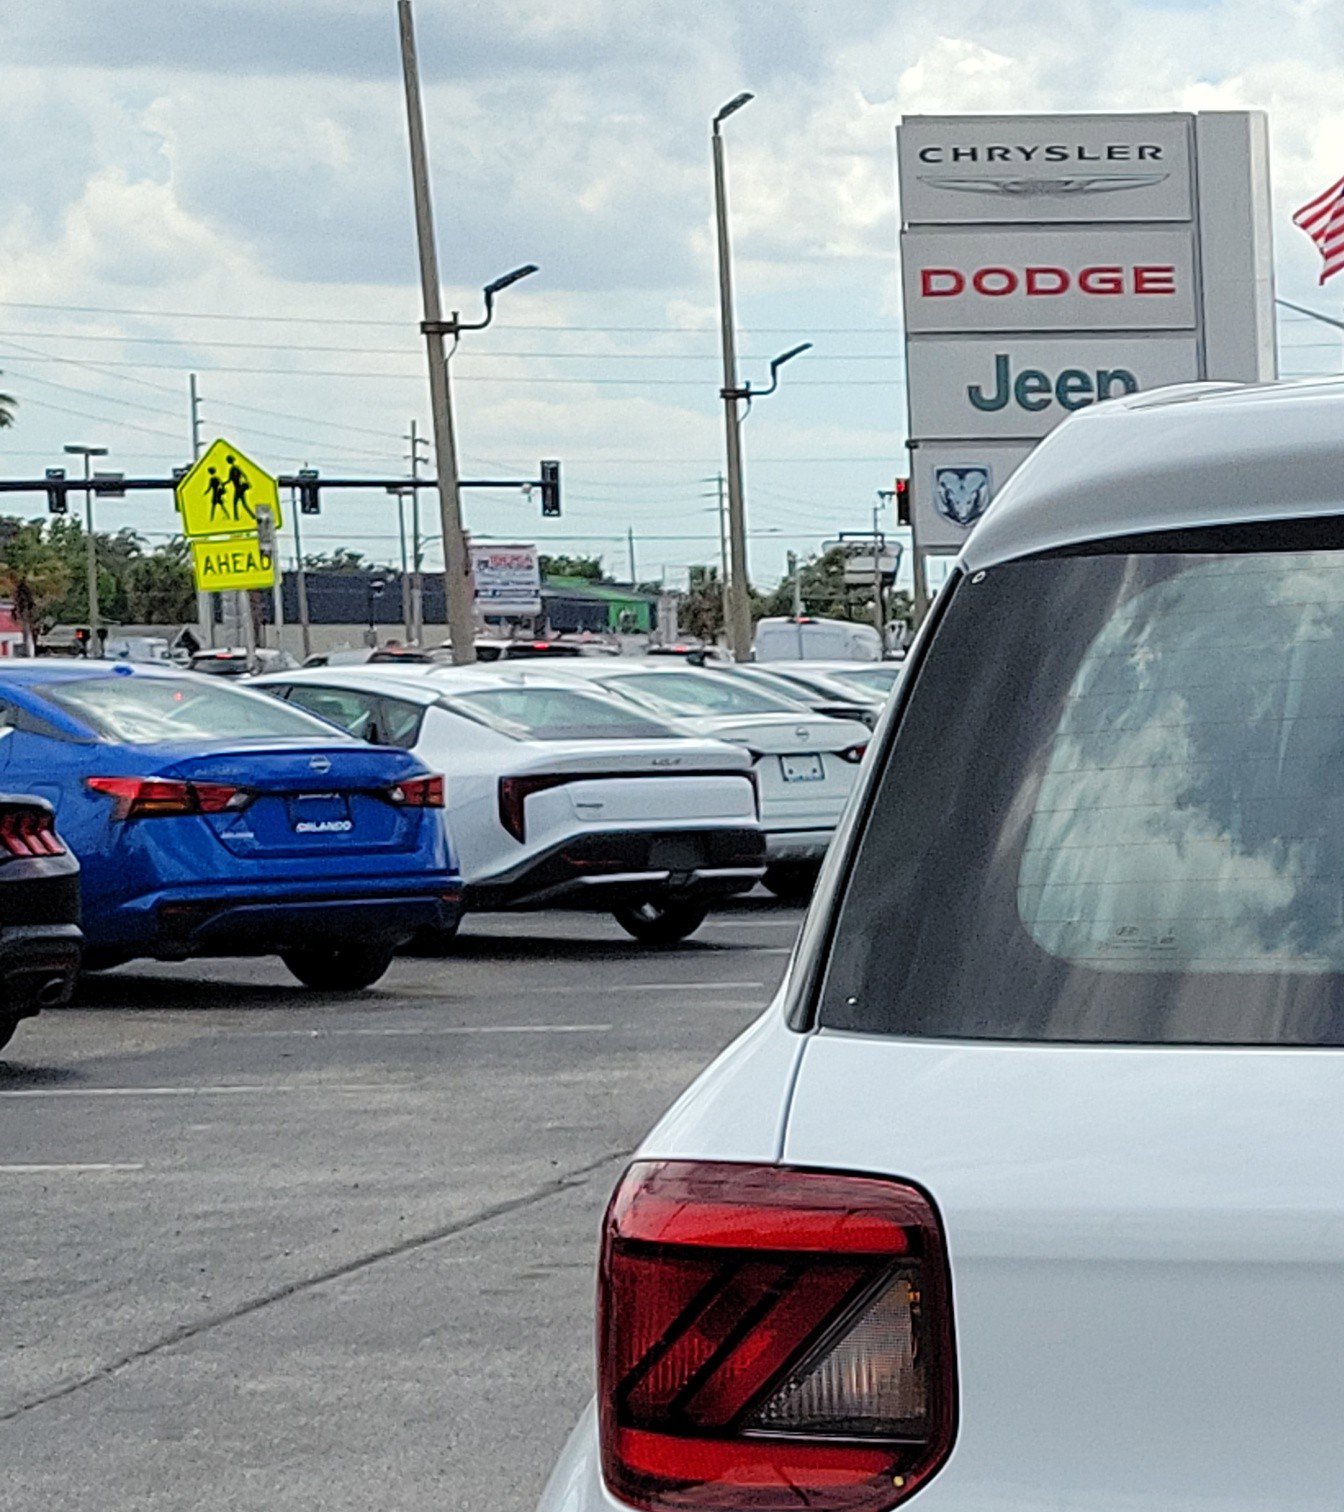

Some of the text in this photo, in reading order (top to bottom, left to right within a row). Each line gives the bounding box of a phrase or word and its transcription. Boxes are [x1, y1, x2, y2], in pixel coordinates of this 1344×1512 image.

[918, 145, 1164, 163] CHRYSLER
[920, 266, 1177, 297] DODGE
[203, 551, 272, 575] AHEAD
